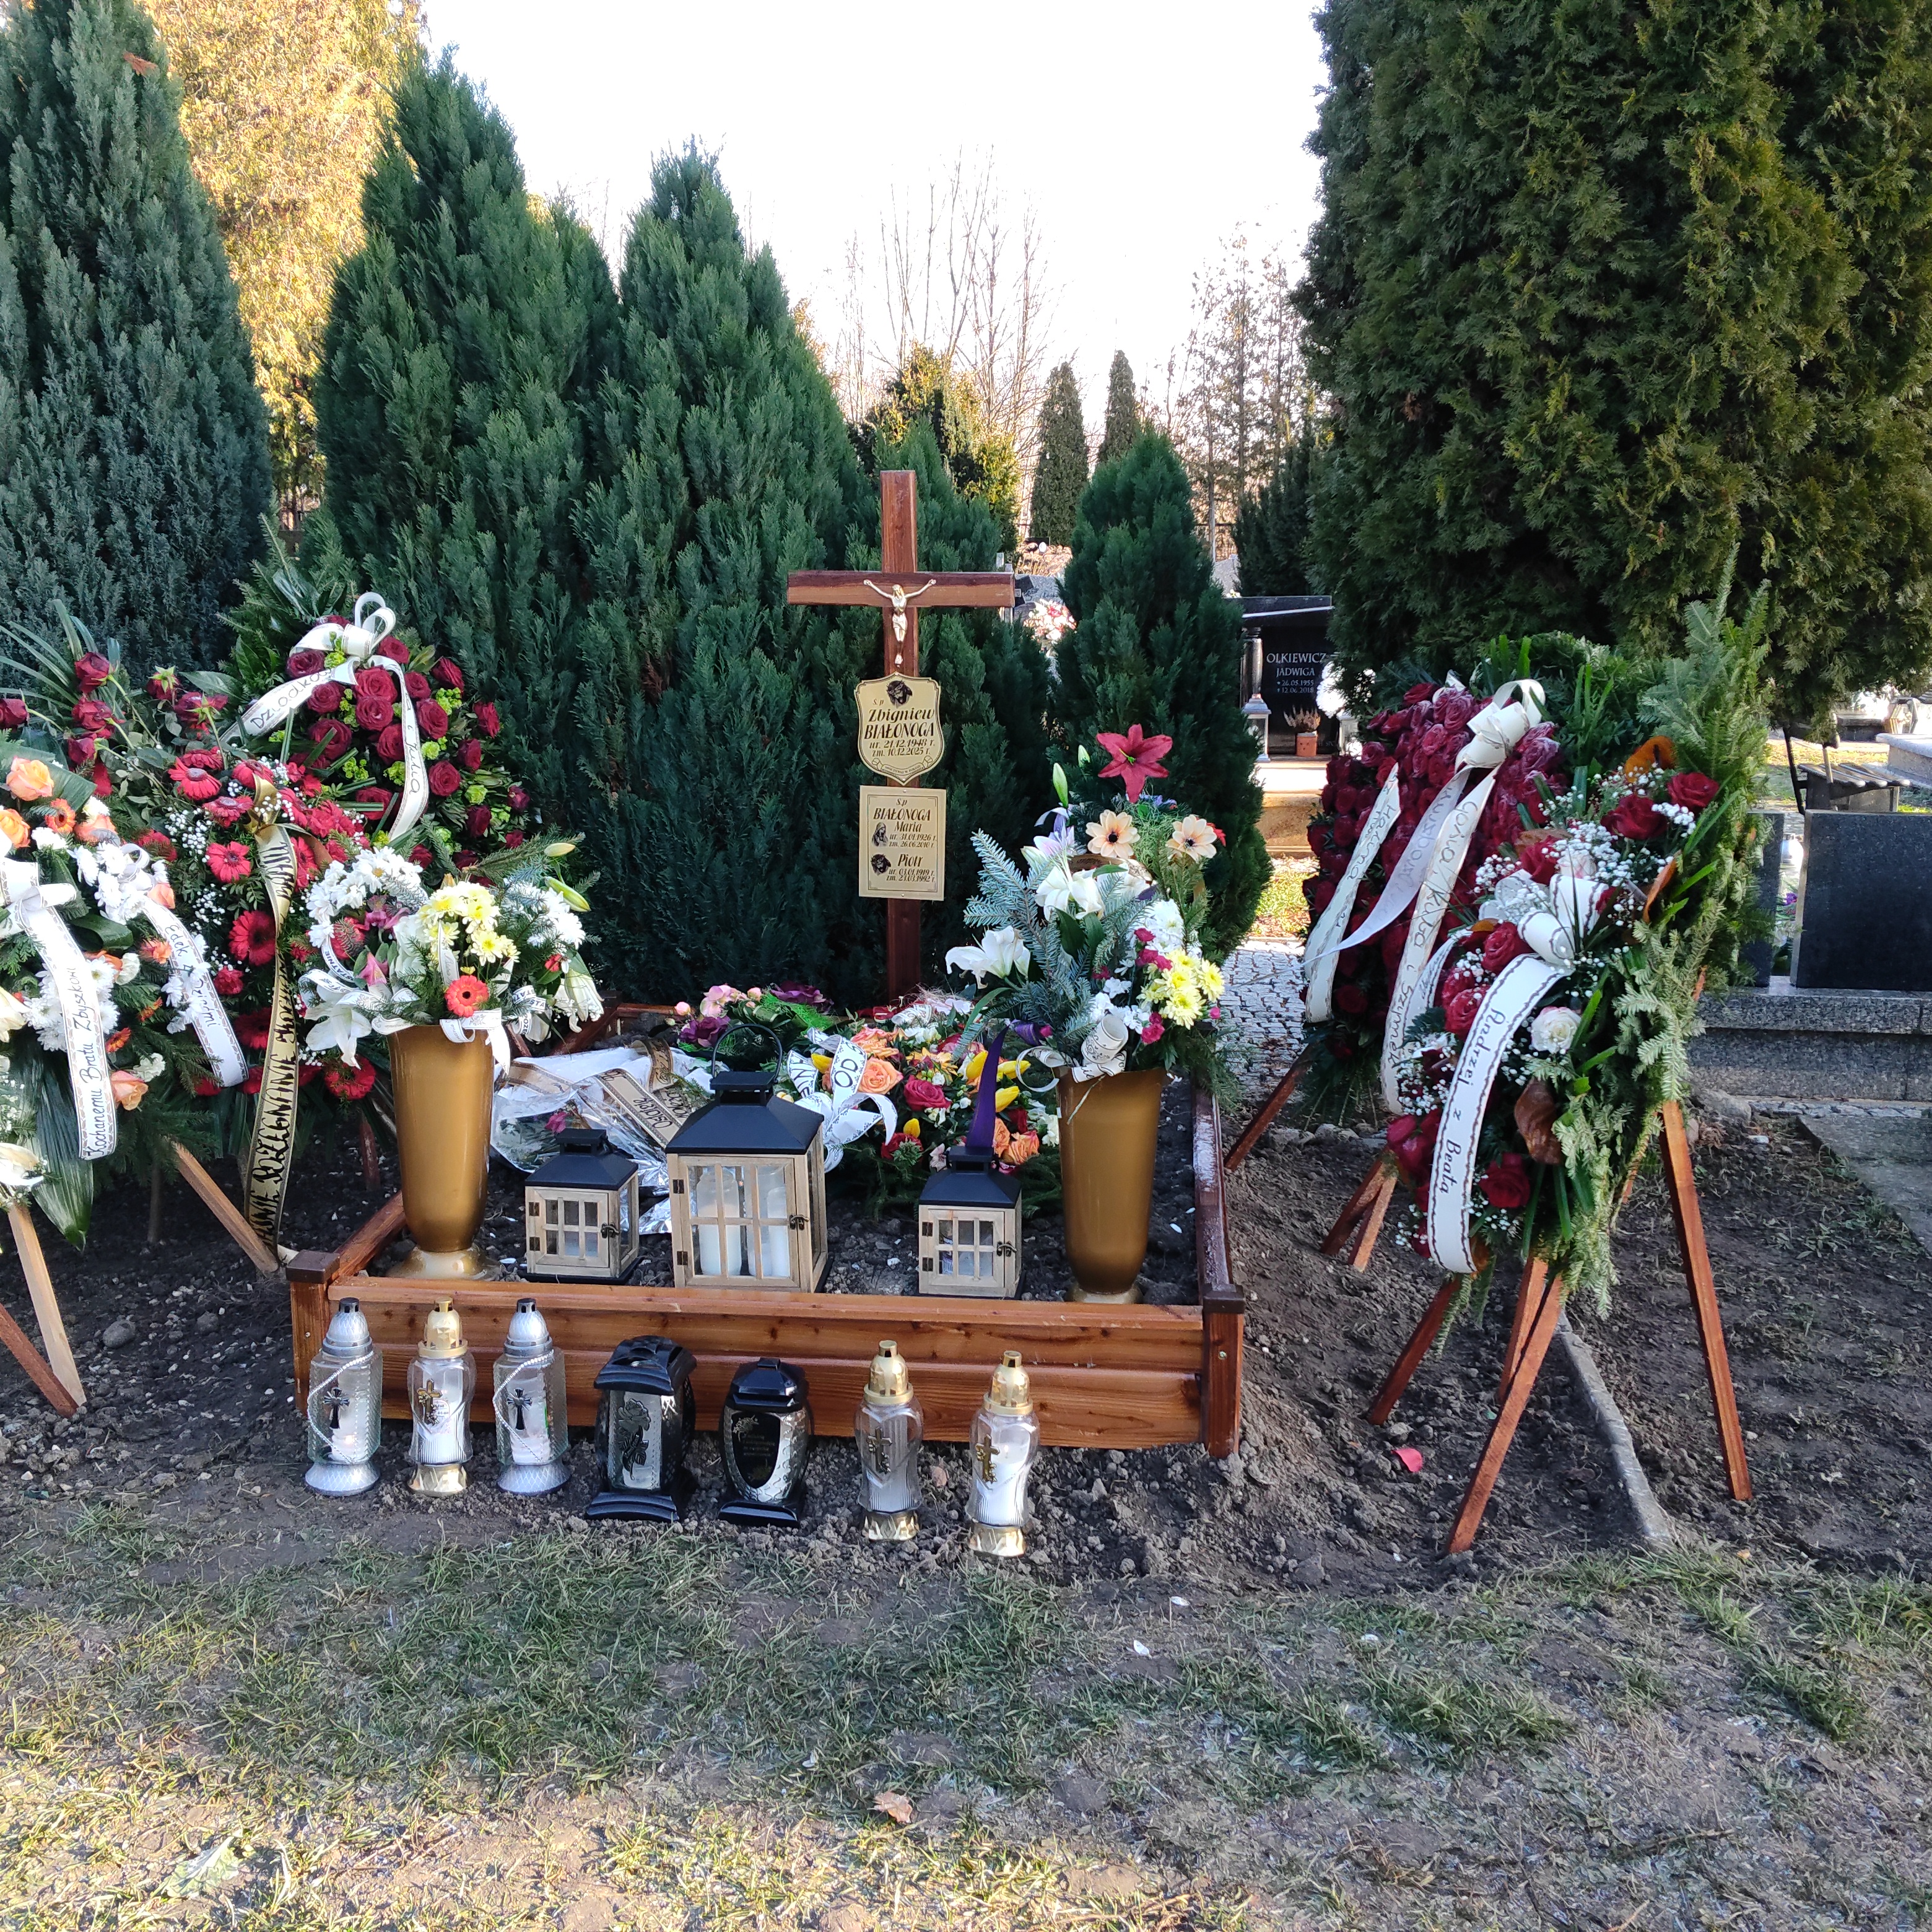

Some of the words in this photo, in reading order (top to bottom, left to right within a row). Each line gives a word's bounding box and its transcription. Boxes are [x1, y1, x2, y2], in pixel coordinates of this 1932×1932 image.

[1266, 653, 1326, 663] OLKIEWICZ
[1276, 668, 1315, 677] JADWIGA
[869, 708, 934, 724] Zbigniew
[864, 722, 934, 739] BIAŁONOGA
[884, 739, 927, 749] 21.12.1948
[888, 747, 924, 756] 10.12.2025
[405, 739, 421, 794] Julia
[873, 807, 930, 820] BIAŁONOGA
[894, 821, 922, 832] Maria
[1347, 804, 1396, 880] Halina
[898, 854, 923, 868] Piotr
[1414, 888, 1445, 947] Kuba
[165, 925, 188, 957] Edek
[67, 968, 95, 1031] Zbyszkowi
[1388, 981, 1412, 1068] Szymek
[1457, 1007, 1506, 1086] Andrzej
[79, 1043, 102, 1084] Bratu
[85, 1088, 105, 1157] Kochanemu
[633, 1097, 673, 1129] Ostatnie
[1453, 1110, 1461, 1121] z
